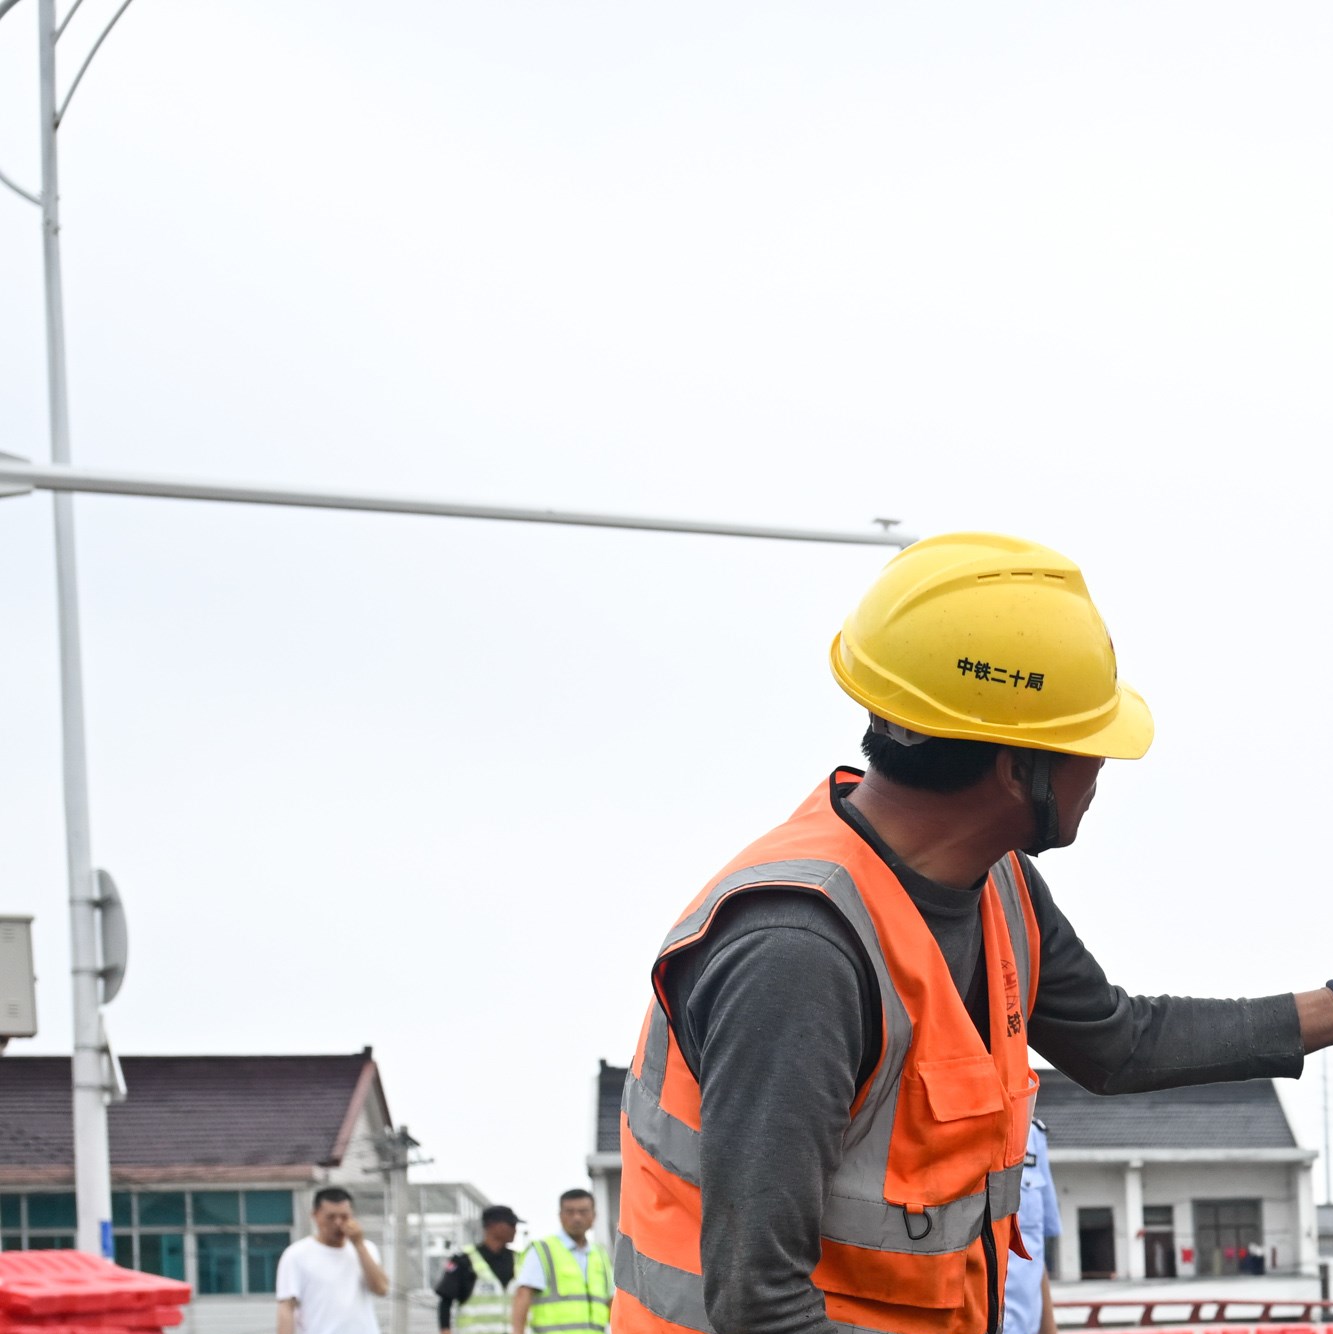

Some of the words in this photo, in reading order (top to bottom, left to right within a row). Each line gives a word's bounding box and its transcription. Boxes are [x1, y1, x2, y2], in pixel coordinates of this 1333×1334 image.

[957, 657, 1045, 691] 中铁二十局
